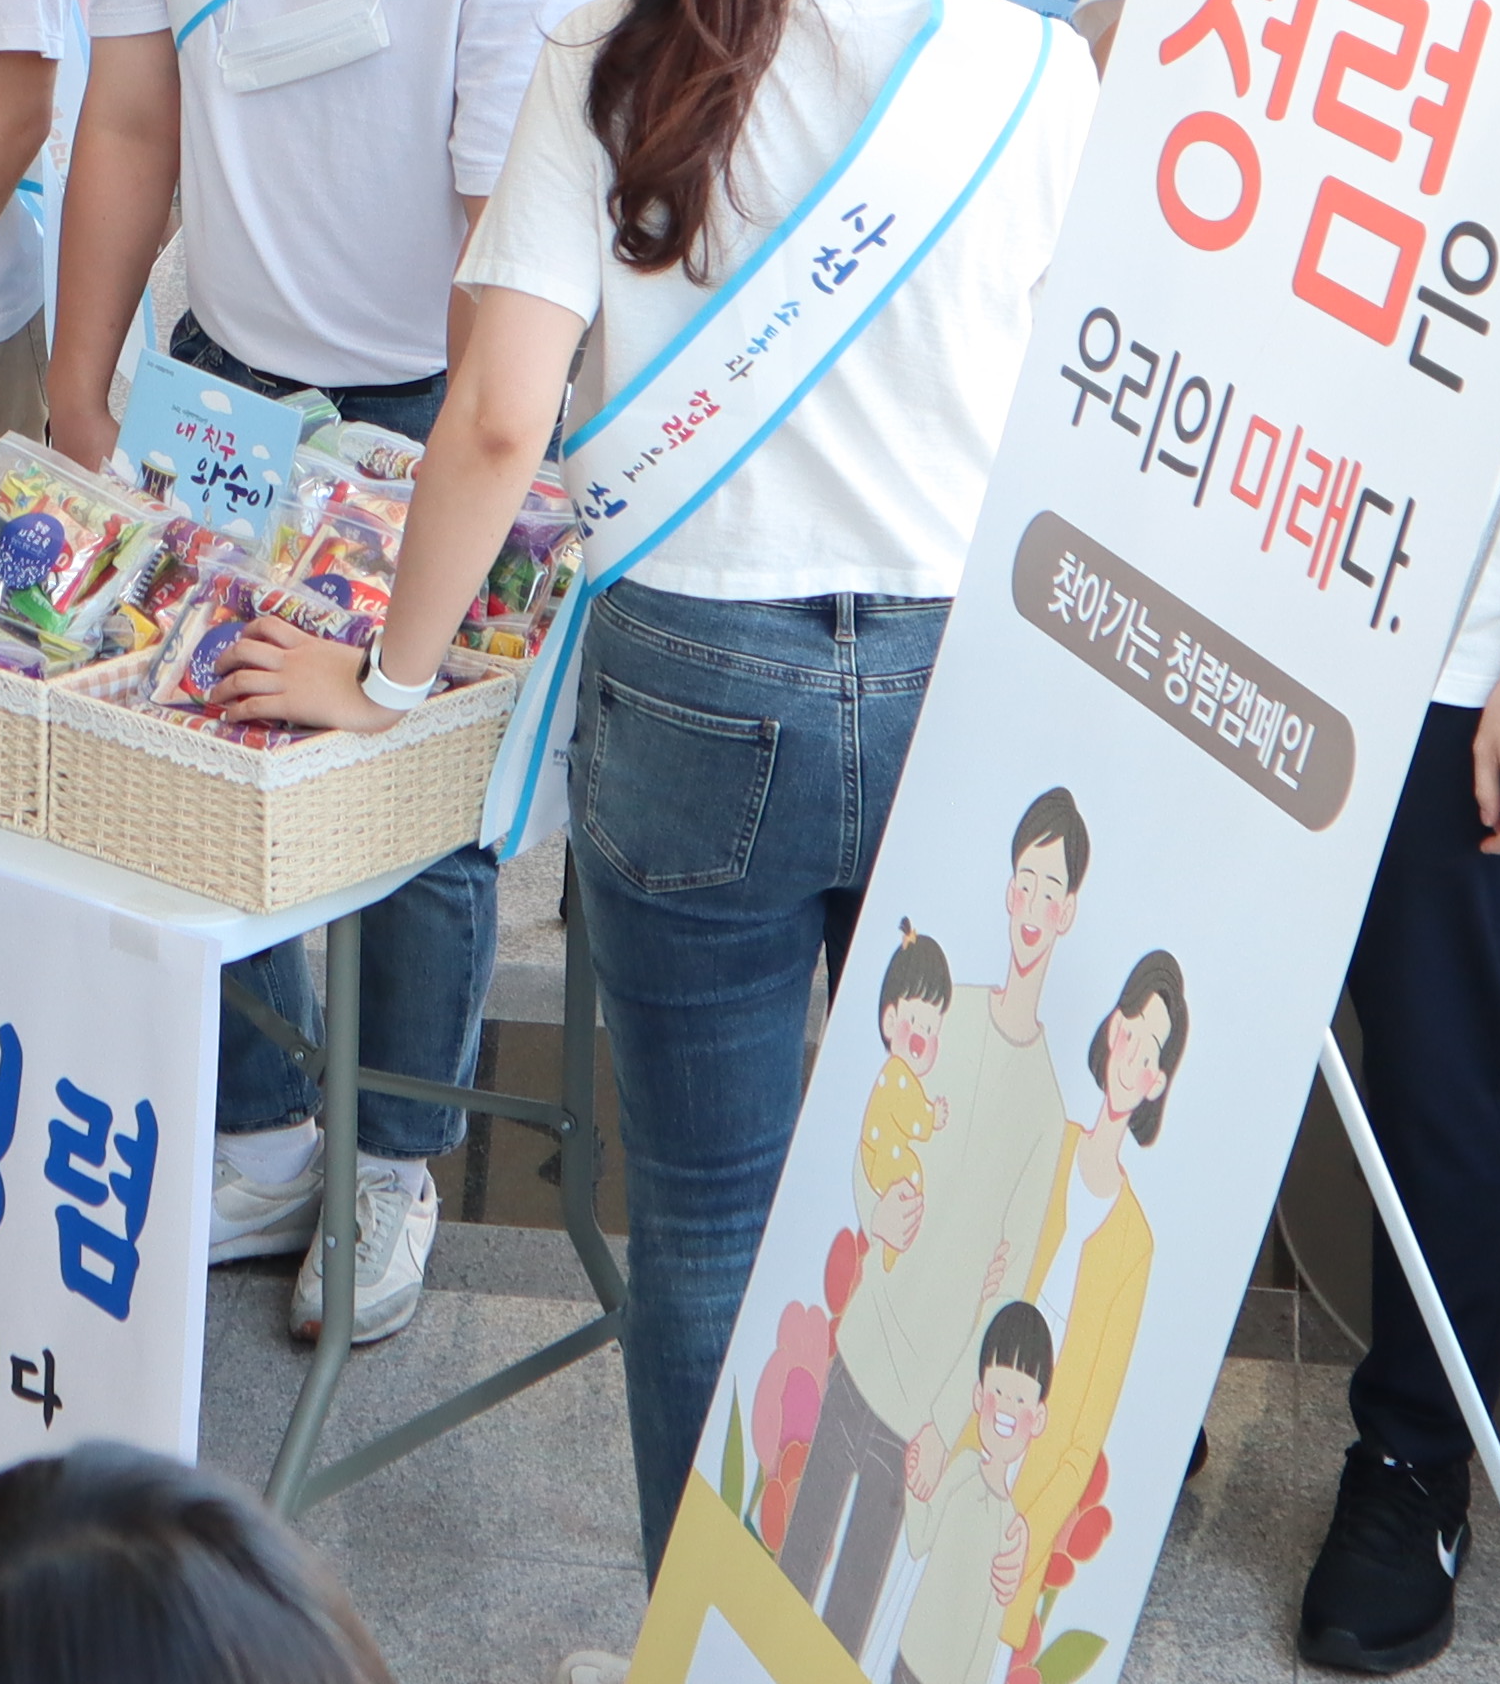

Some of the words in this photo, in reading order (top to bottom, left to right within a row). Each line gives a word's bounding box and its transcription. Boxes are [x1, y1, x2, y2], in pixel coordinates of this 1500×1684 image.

[810, 202, 898, 296] 사천
[723, 299, 802, 383] 소통과
[175, 421, 198, 444] 내
[201, 423, 237, 463] 친구
[621, 387, 723, 485] 협력으로
[1058, 305, 1236, 509] 우리의
[1229, 410, 1412, 636] 미래다.
[190, 457, 274, 513] 왕순이
[1046, 547, 1161, 692] 찾아가는
[1163, 624, 1316, 792] 청렴캠페인
